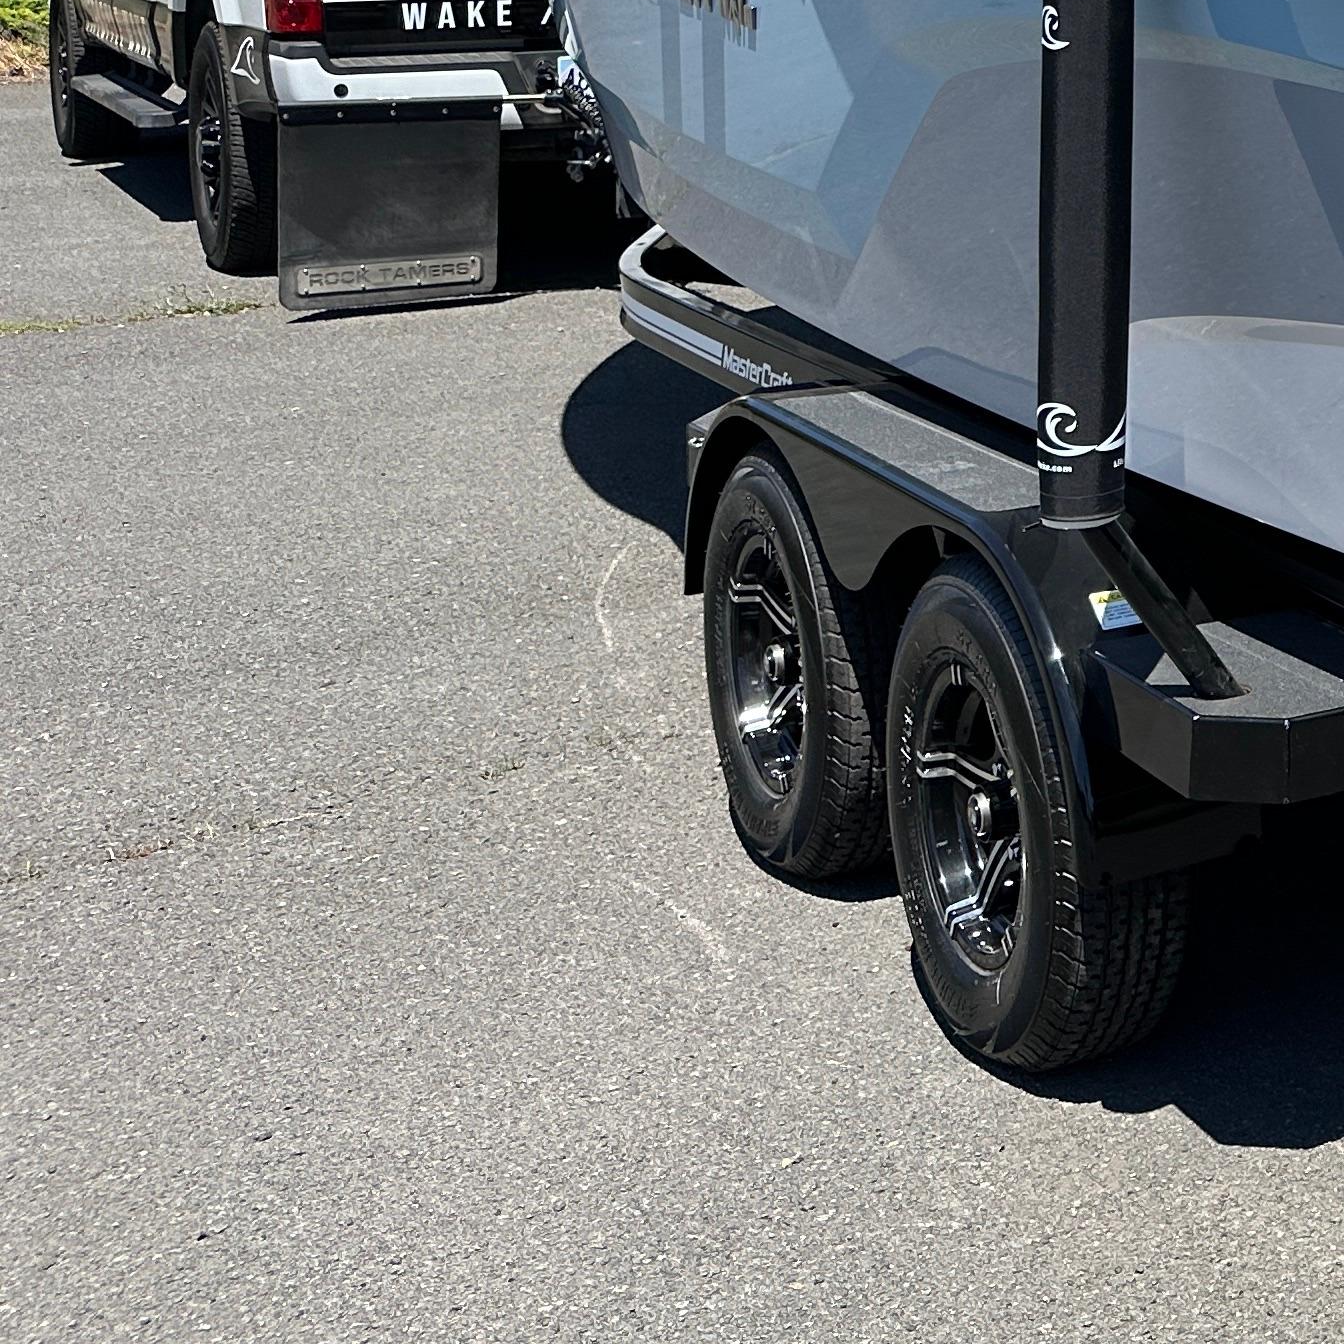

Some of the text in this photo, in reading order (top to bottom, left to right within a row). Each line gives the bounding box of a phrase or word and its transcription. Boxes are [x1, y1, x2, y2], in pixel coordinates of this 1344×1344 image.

[401, 0, 513, 31] WAKE
[309, 262, 471, 287] ROCK TAMERS
[723, 345, 793, 388] MasterCraft
